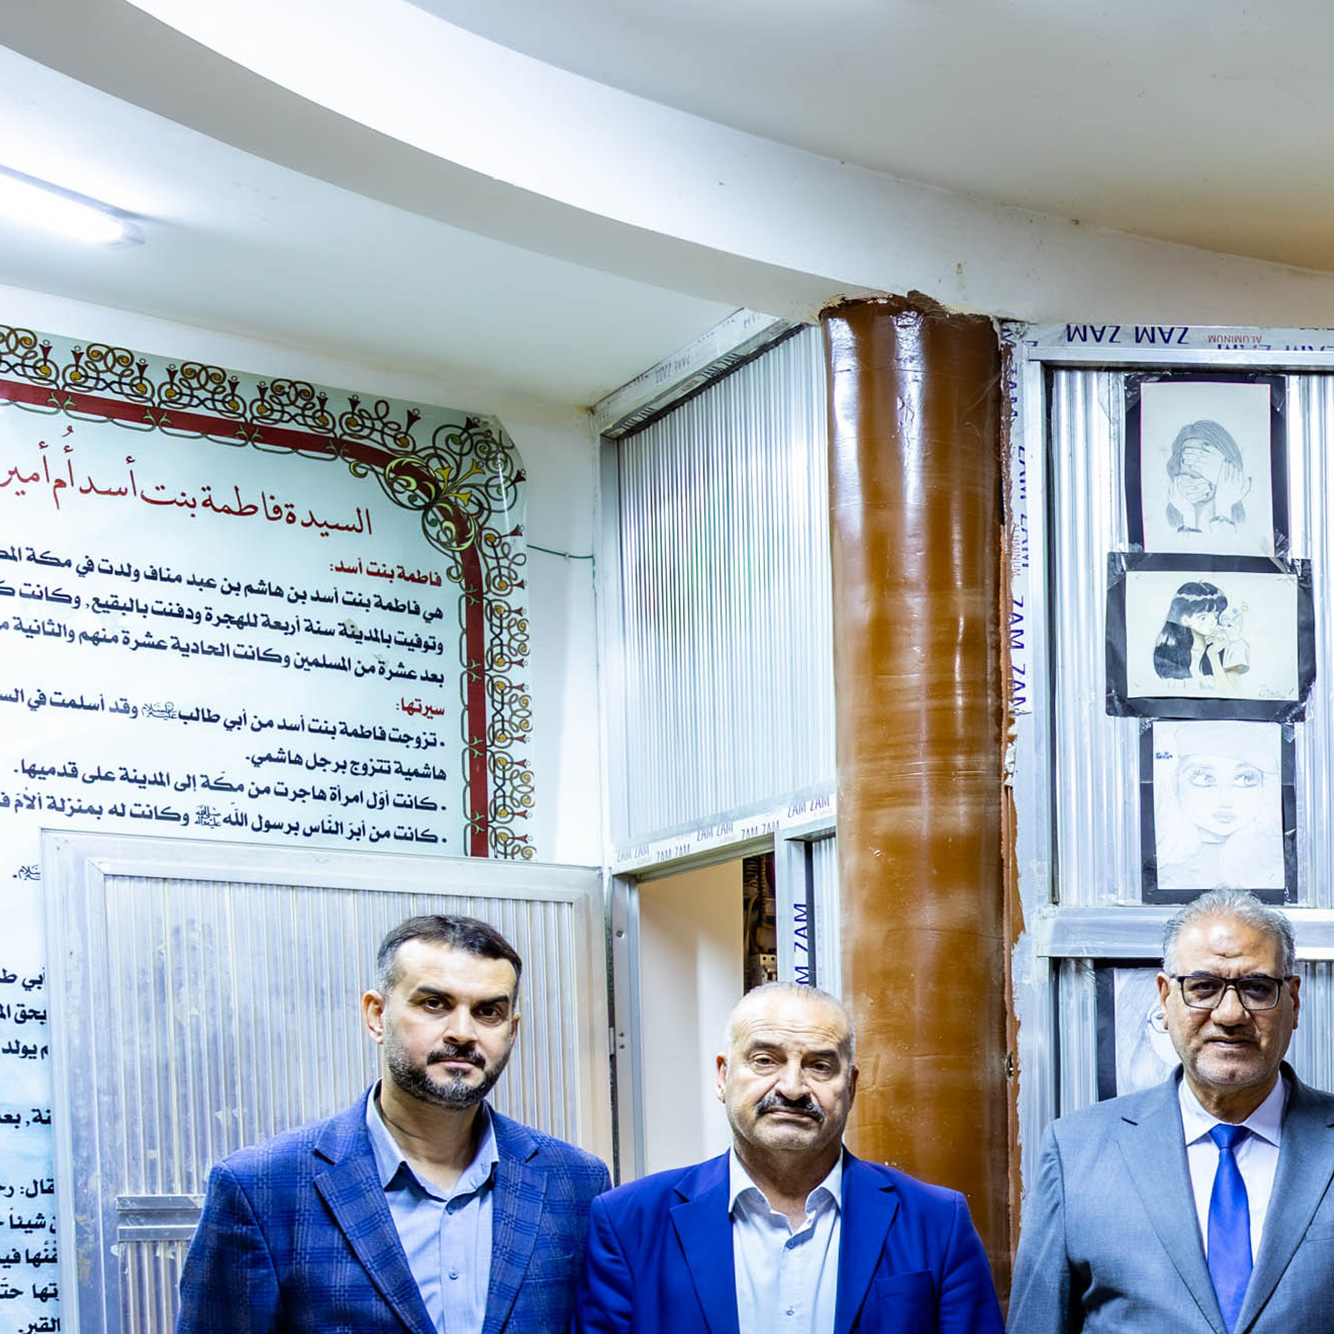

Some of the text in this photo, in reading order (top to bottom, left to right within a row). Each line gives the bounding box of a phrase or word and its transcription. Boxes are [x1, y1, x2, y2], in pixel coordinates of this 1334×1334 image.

[1067, 324, 1120, 343] ZAM
[1134, 326, 1189, 345] ZAM
[79, 455, 137, 497] أسد
[140, 485, 197, 518] بنت
[201, 485, 282, 521] فاطمة
[285, 503, 373, 537] السيدة
[330, 558, 442, 587] فاطمة بنت أسد:
[19, 583, 81, 609] وكانت
[25, 547, 443, 624] هي فاطمة بنت أسد بن هاشم بن عبد مناف ولدت في مكة
[151, 600, 202, 625] ودفنت
[204, 606, 258, 630] للهجرة
[260, 613, 300, 635] أربعة
[303, 619, 335, 636] سنة
[338, 623, 392, 648] بالمدينة
[12, 616, 444, 688] بعد عشرة من المسلمين وكانت الحادية عشرة منهم والثانية
[394, 631, 444, 655] وتوفيت
[27, 689, 47, 712] في
[49, 691, 105, 711] أسلمت
[109, 698, 138, 719] وقد
[178, 707, 221, 725] طالب
[223, 709, 247, 732] أبي
[250, 715, 274, 732] من
[277, 714, 305, 732] أسد
[308, 718, 337, 740] بنت
[338, 721, 386, 741] فاطمة
[388, 728, 437, 750] تزوجت
